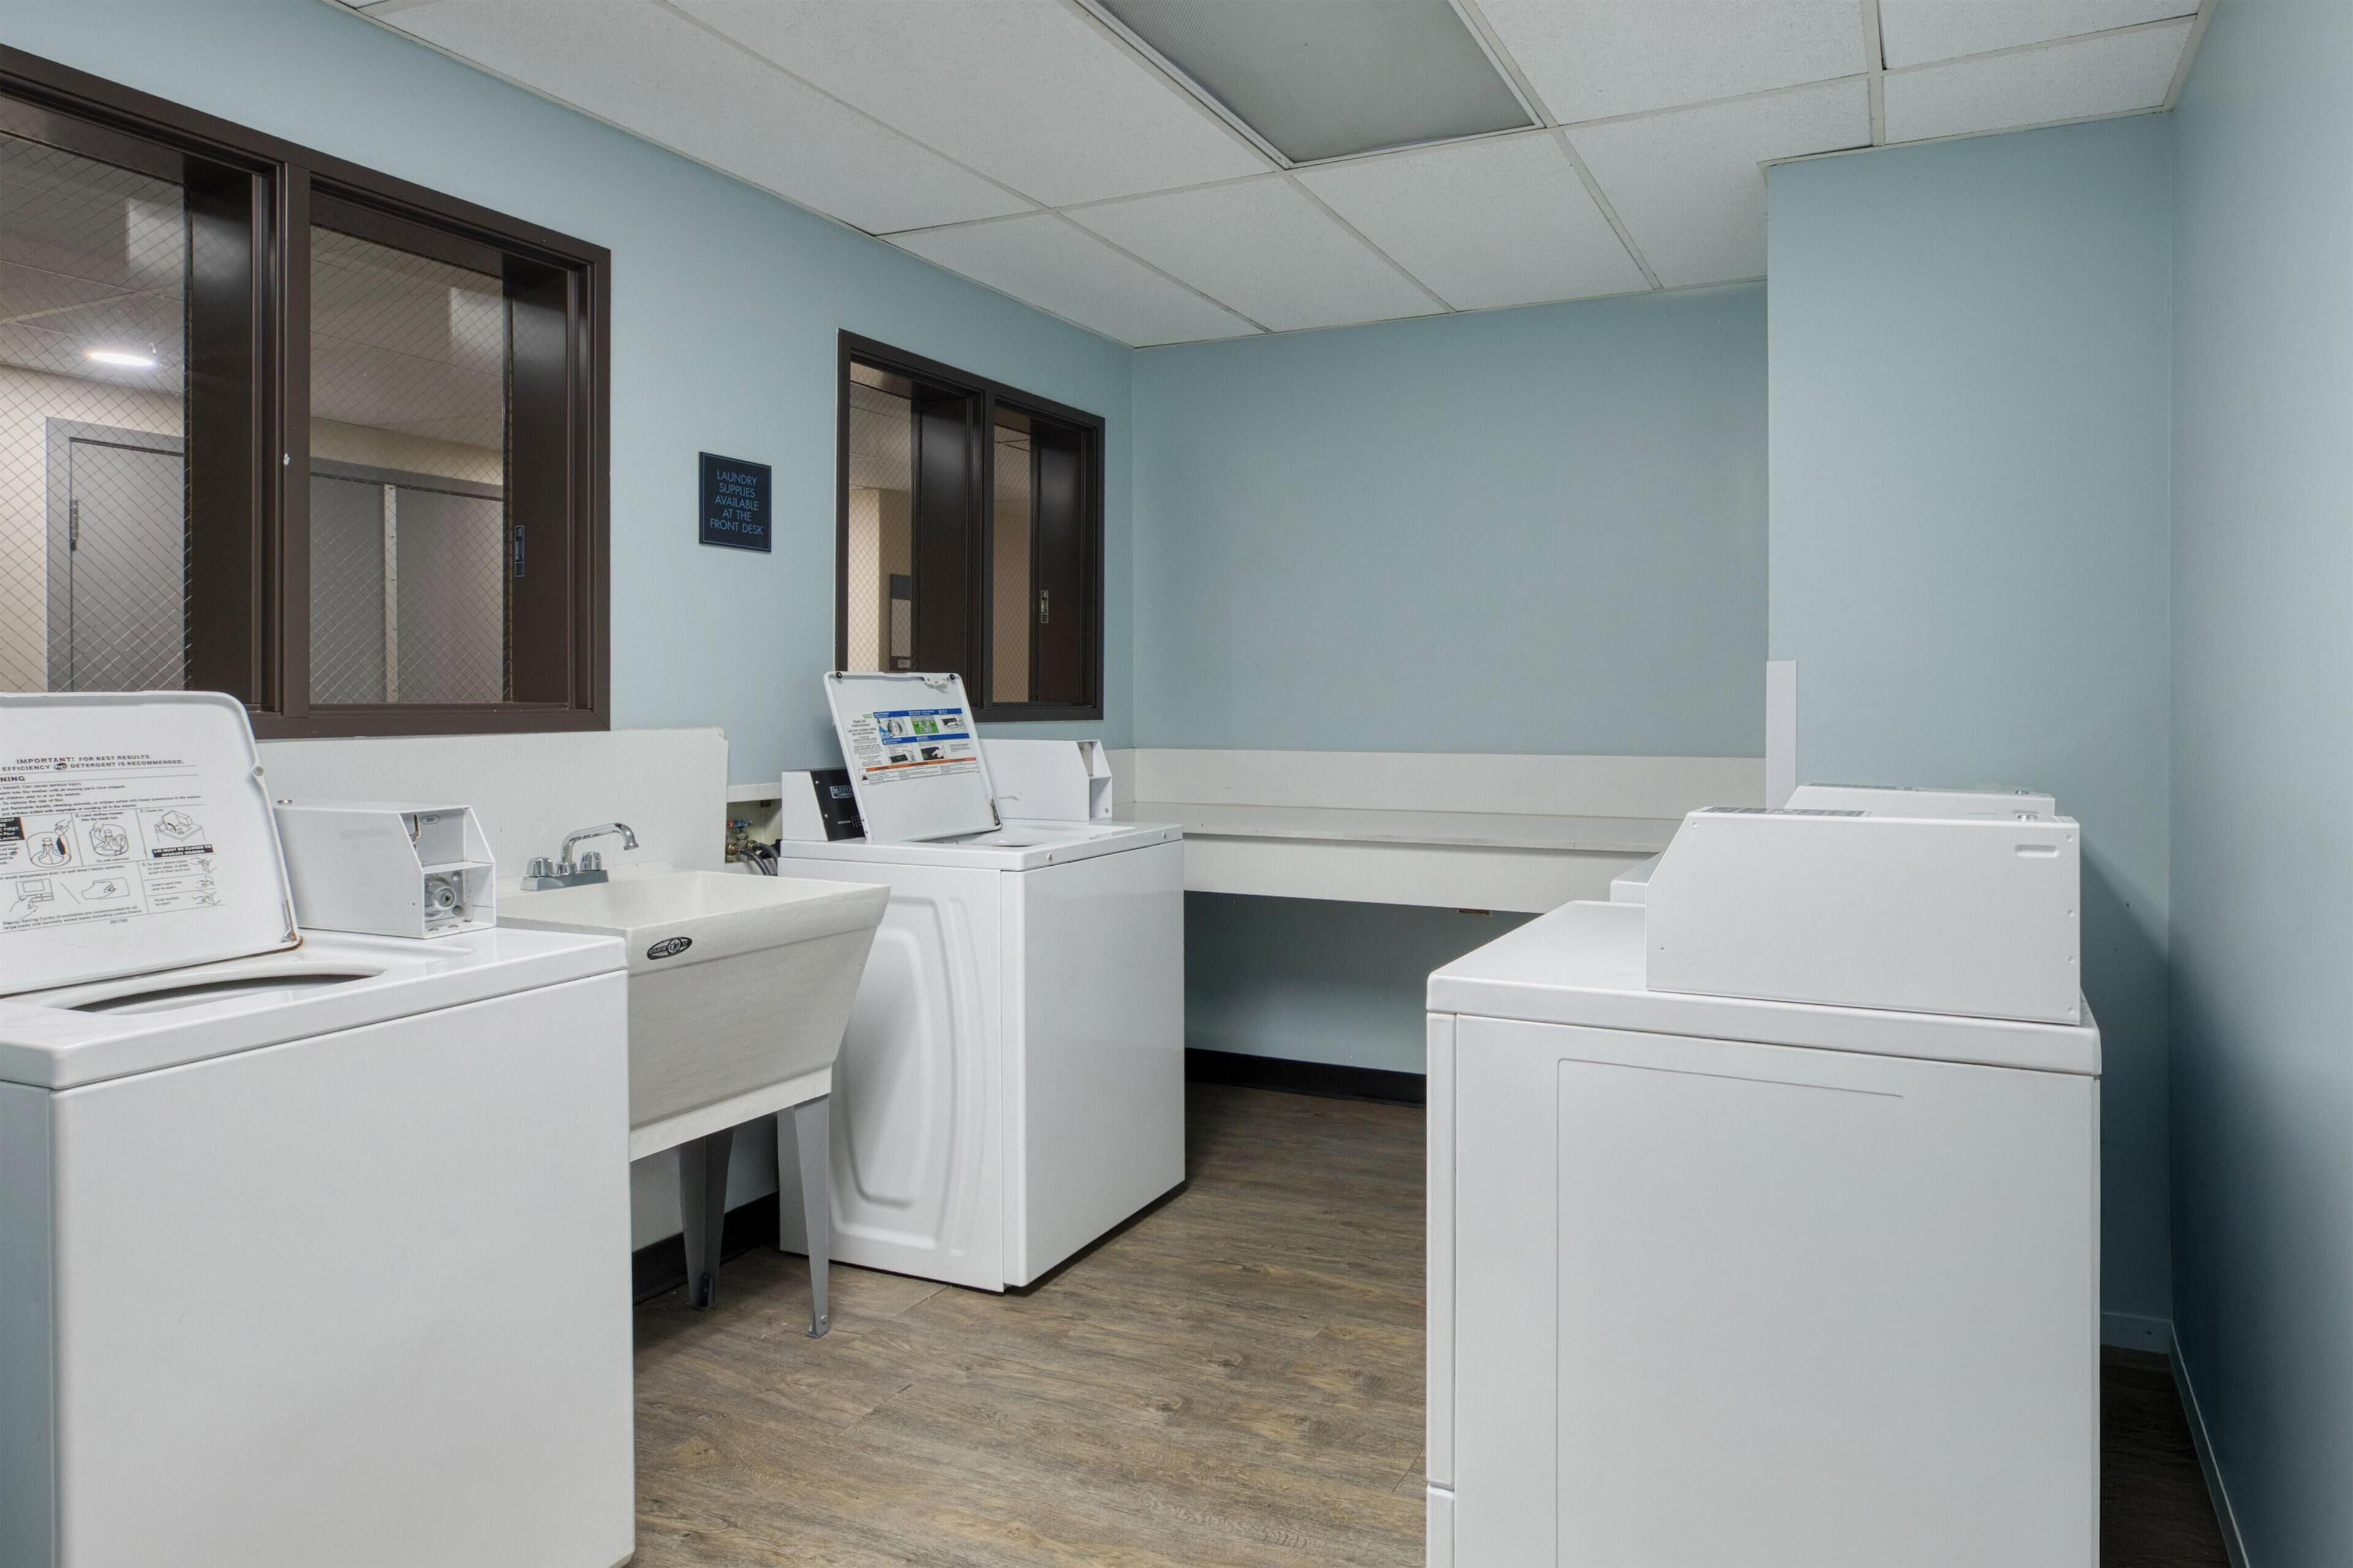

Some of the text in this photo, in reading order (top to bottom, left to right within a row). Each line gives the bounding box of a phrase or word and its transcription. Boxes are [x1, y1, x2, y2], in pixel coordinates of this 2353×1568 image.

[717, 470, 757, 486] LAUNDRY
[719, 483, 755, 498] SUPPLIES
[715, 495, 759, 510] AVAILABLE
[722, 509, 751, 521] AT THE
[710, 518, 763, 535] FRONT DESK
